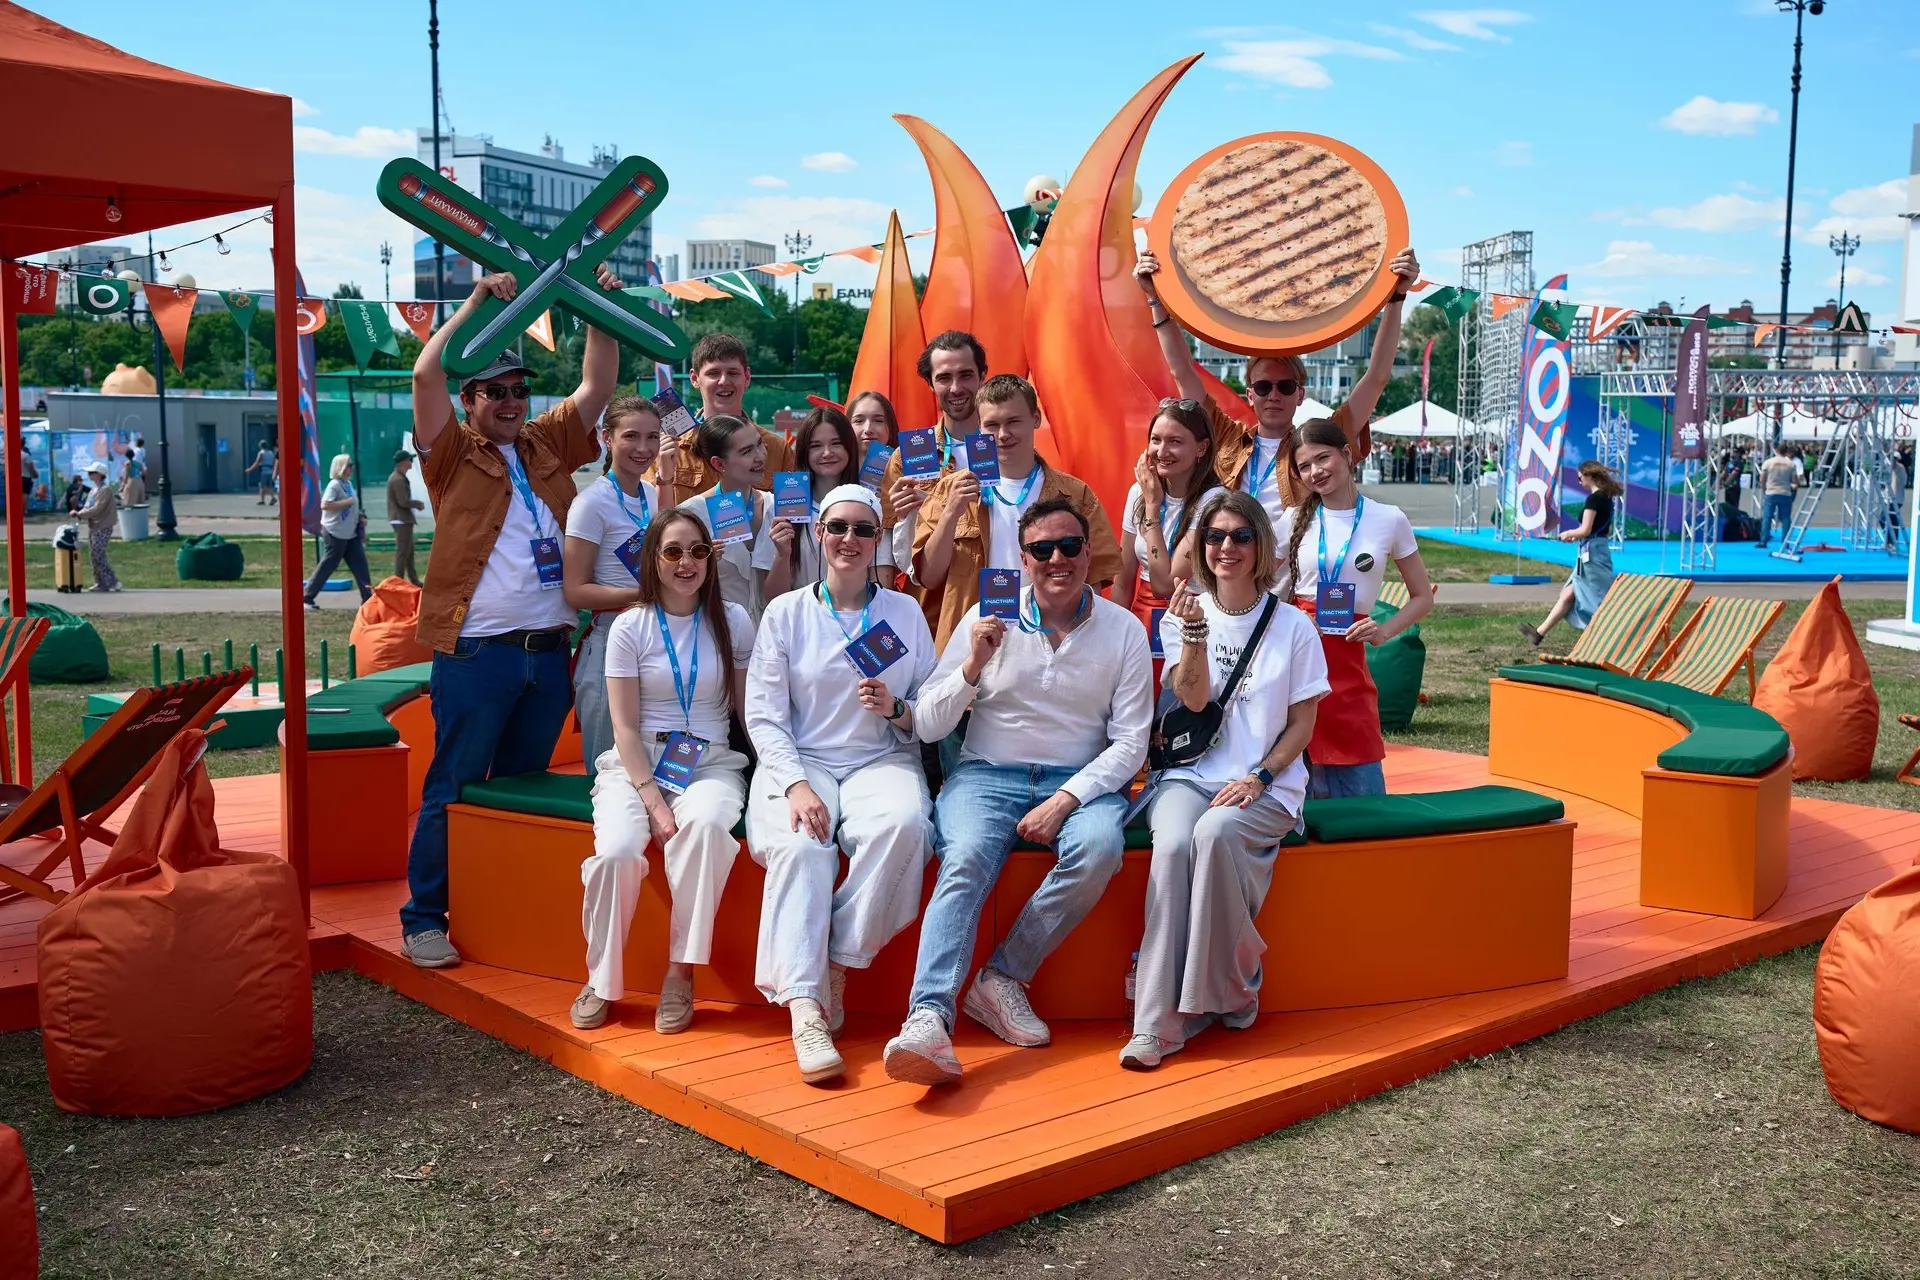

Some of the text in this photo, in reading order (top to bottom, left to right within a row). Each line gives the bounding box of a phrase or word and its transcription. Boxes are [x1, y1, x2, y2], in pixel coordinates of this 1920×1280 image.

[428, 195, 479, 229] ИНДИЛАЙТ
[716, 516, 744, 529] ПЕРСОНАЛ
[1215, 643, 1227, 655] I'M
